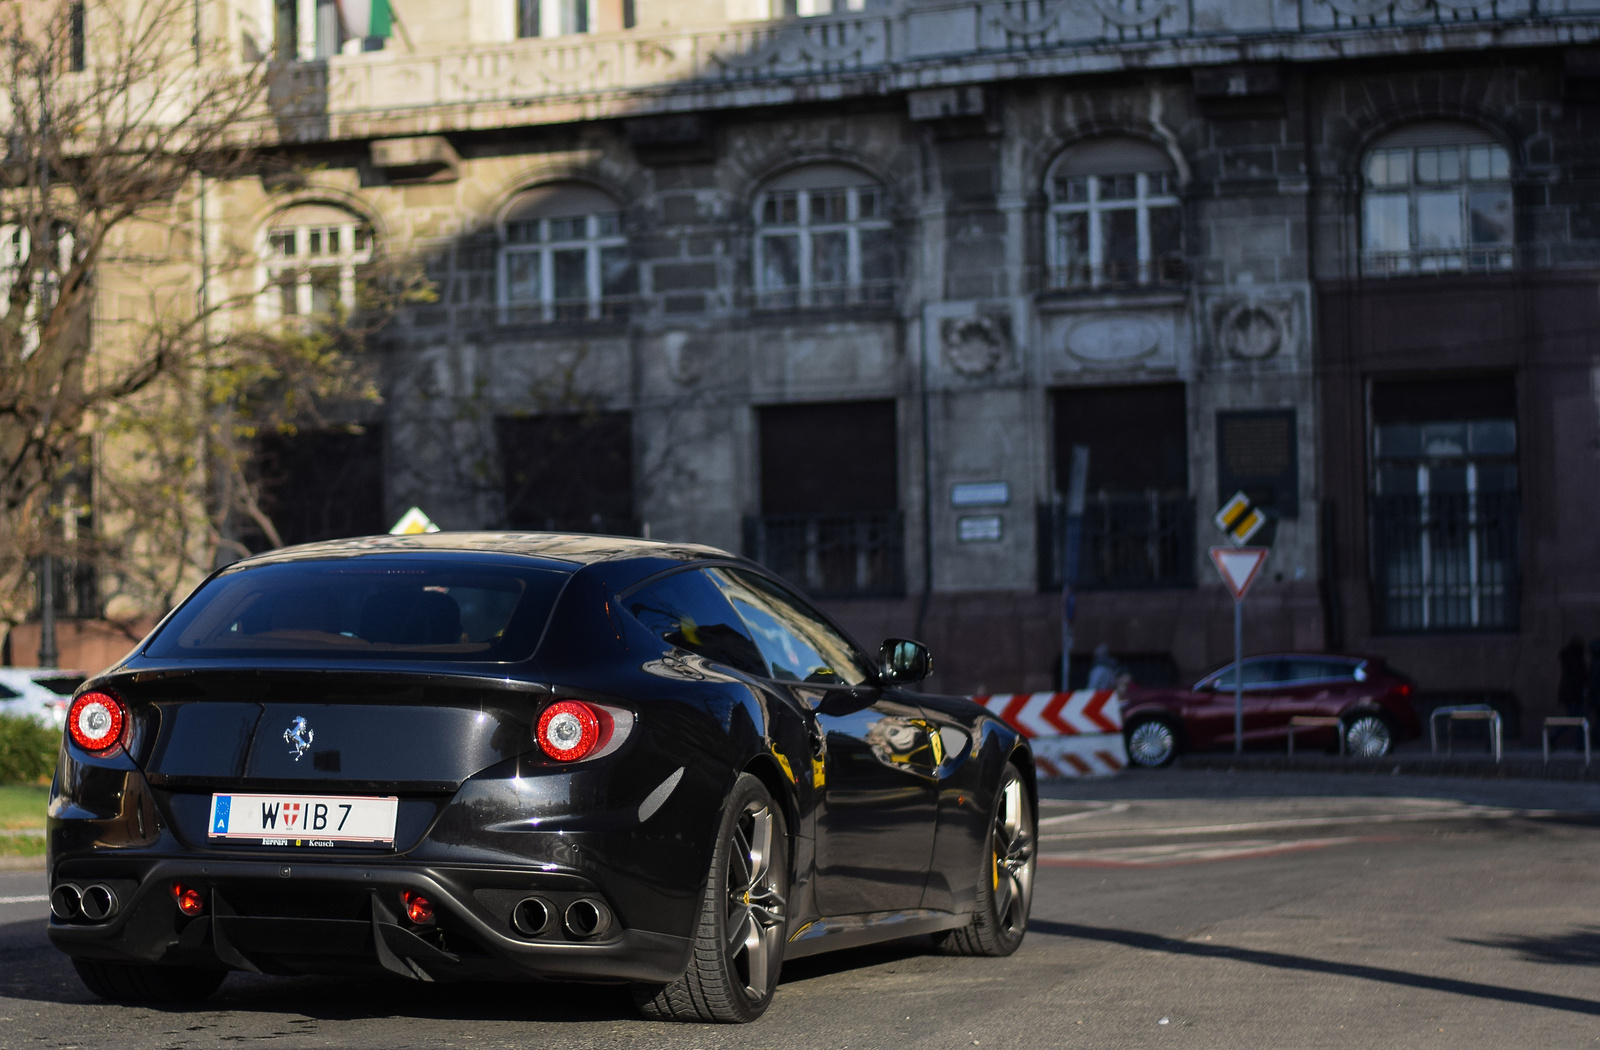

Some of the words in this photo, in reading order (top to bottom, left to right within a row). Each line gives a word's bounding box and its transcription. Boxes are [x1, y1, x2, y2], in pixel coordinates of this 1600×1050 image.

[262, 802, 280, 829] W
[217, 819, 225, 828] A
[262, 838, 288, 846] Ferrari
[308, 839, 334, 848] Keusch
